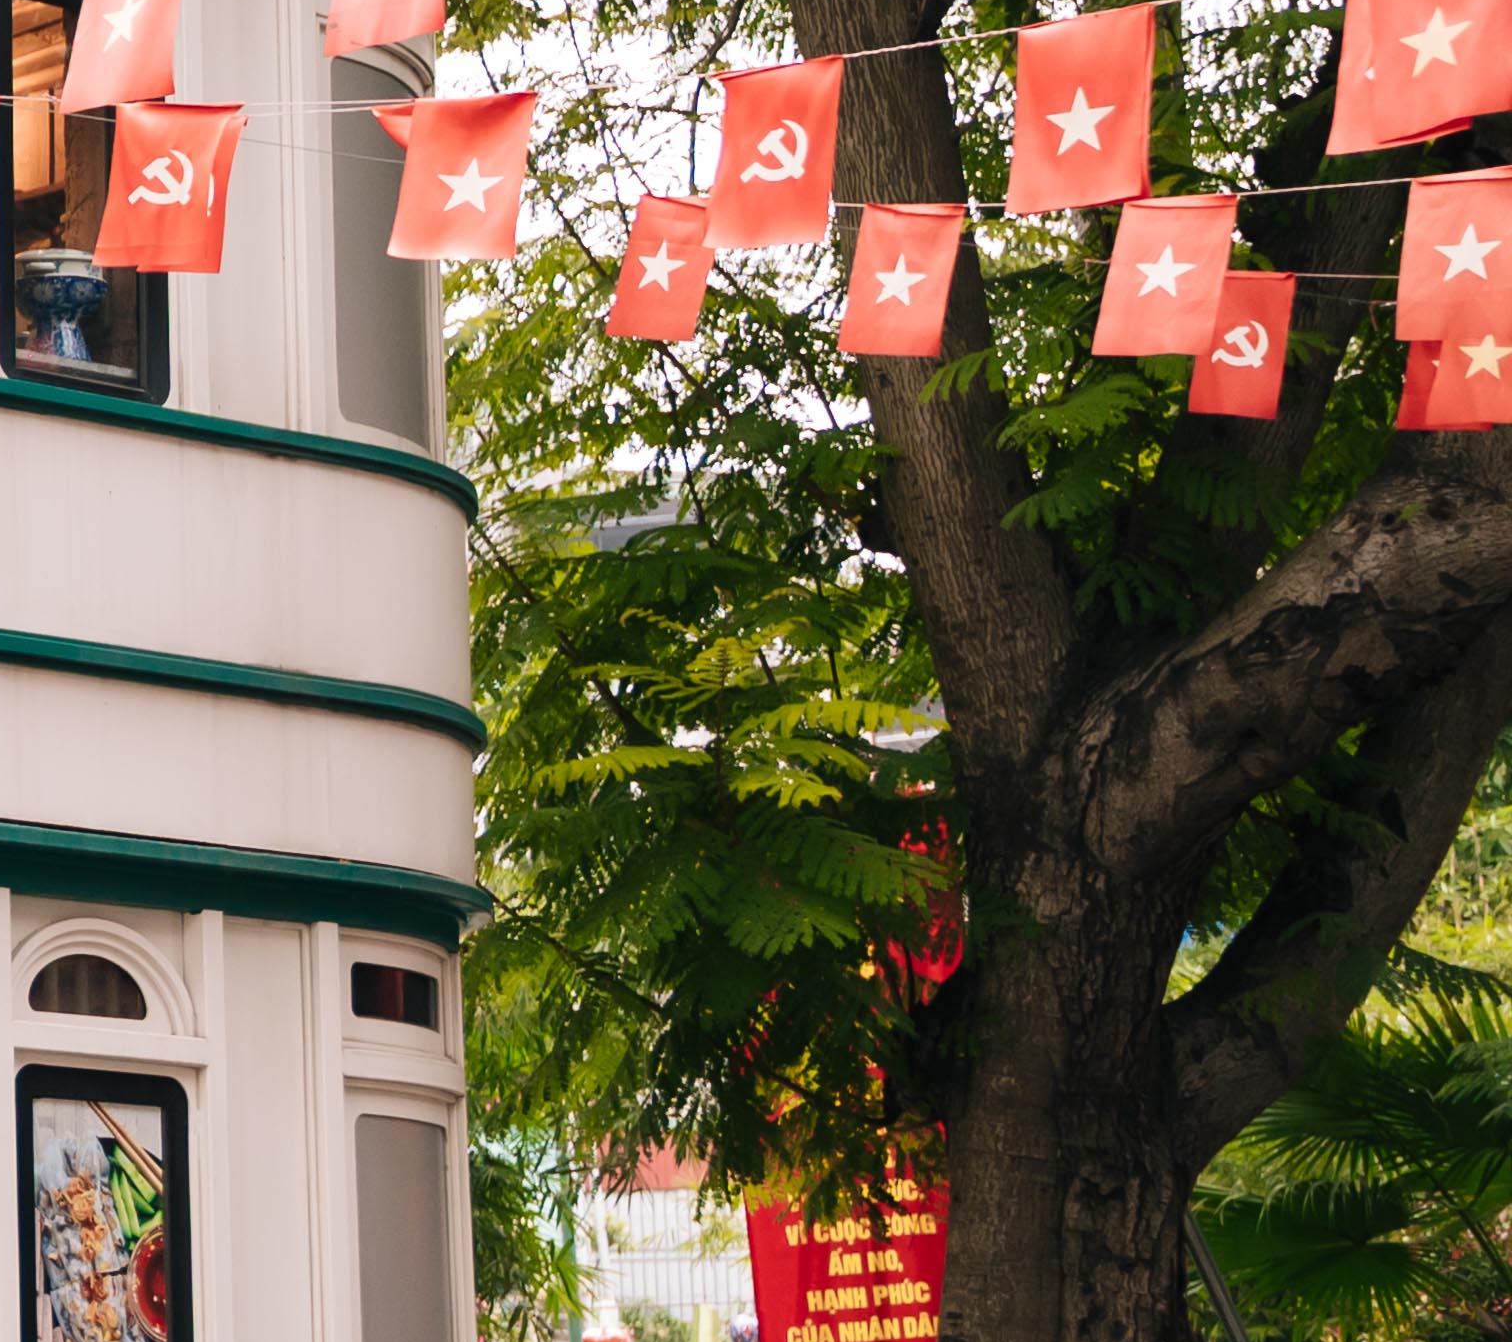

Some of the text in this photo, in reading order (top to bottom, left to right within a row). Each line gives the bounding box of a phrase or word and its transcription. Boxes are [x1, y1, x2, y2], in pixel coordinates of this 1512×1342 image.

[828, 1247, 864, 1277] ẤM
[806, 1278, 932, 1315] HẠNH PHÚC
